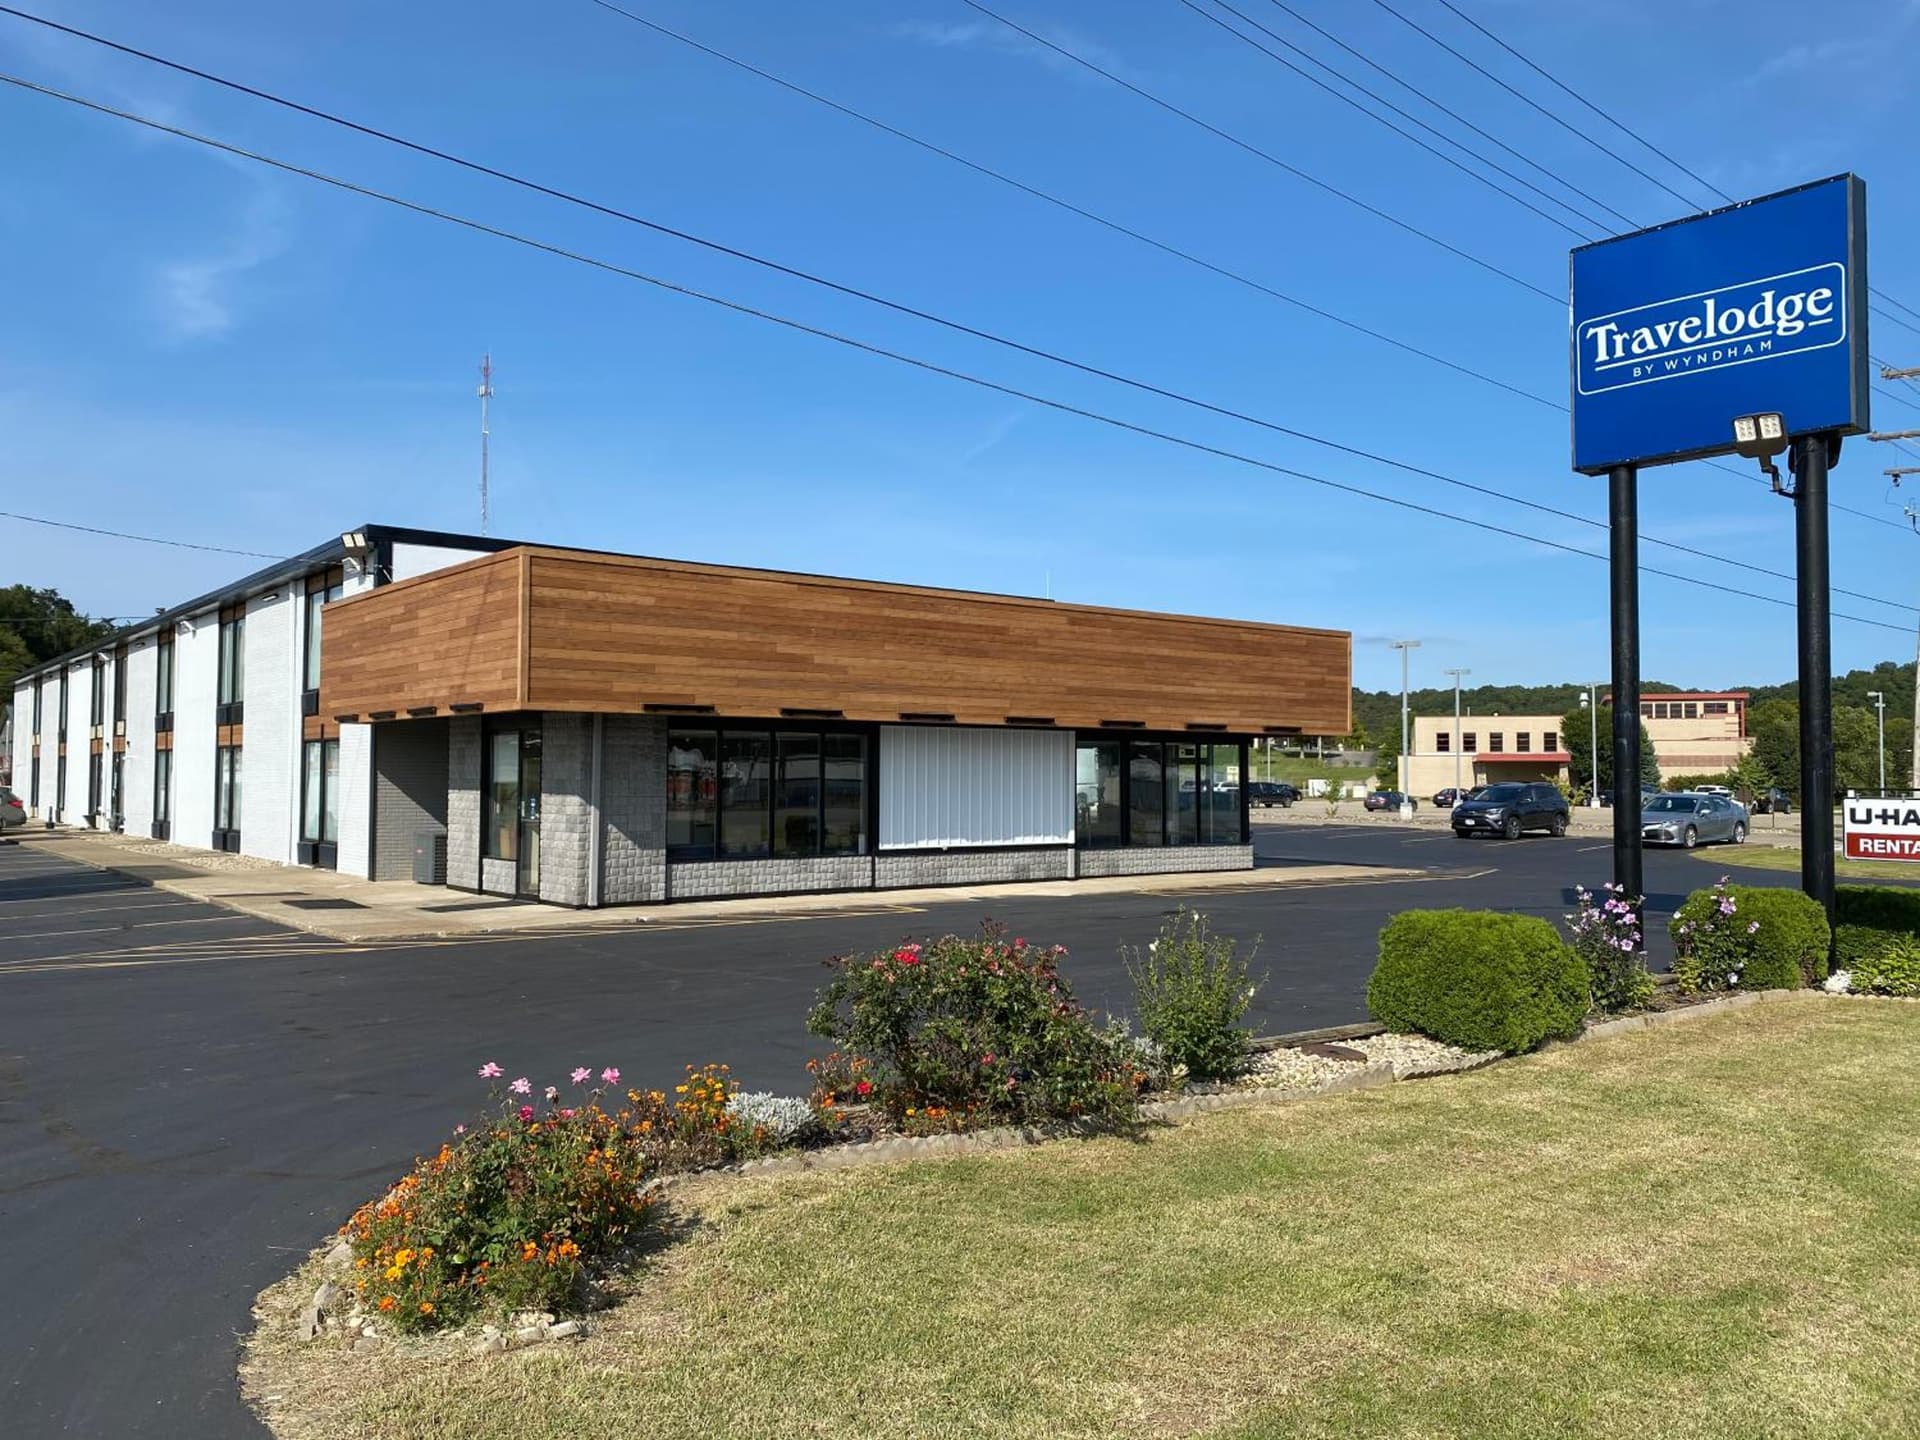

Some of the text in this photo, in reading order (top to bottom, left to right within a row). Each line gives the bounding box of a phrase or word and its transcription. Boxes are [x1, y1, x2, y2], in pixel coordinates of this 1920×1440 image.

[1586, 288, 1832, 362] Travelodge
[1632, 340, 1773, 377] BY WYNDHAM
